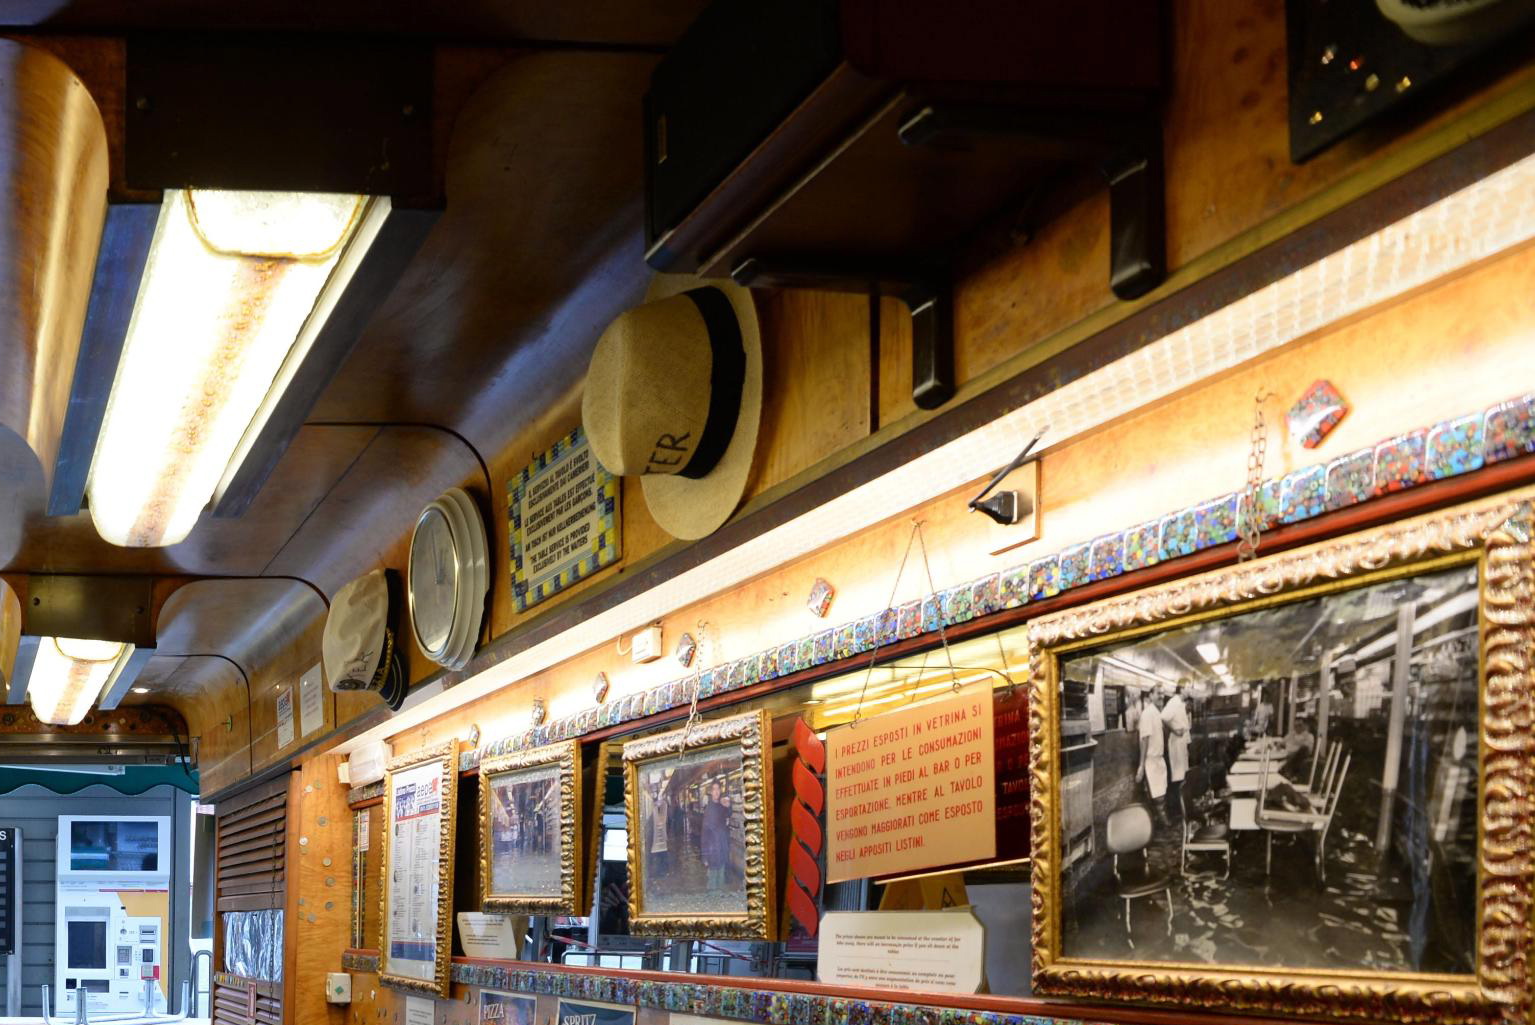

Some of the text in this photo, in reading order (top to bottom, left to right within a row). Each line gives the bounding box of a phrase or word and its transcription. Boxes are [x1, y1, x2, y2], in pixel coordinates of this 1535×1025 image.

[842, 739, 869, 757] PREZZI
[874, 728, 908, 748] ESPOSTI
[914, 722, 921, 734] IN
[927, 709, 966, 731] VETRINA
[972, 704, 981, 718] SI
[836, 728, 982, 779] INTENDONO PER LE CONSUMAZIONI
[836, 752, 982, 800] EFFETTUATE IN PIEDI AL BAR O PER
[896, 788, 927, 807] MENTRE
[934, 785, 944, 798] AL
[950, 776, 982, 794] TAVOLO
[836, 800, 982, 841] VENGONO MAGGIORATI COME ESPOSTO
[836, 848, 855, 862] NEGLI
[859, 842, 892, 858] APPOSITI
[484, 1003, 504, 1019] PIZZA
